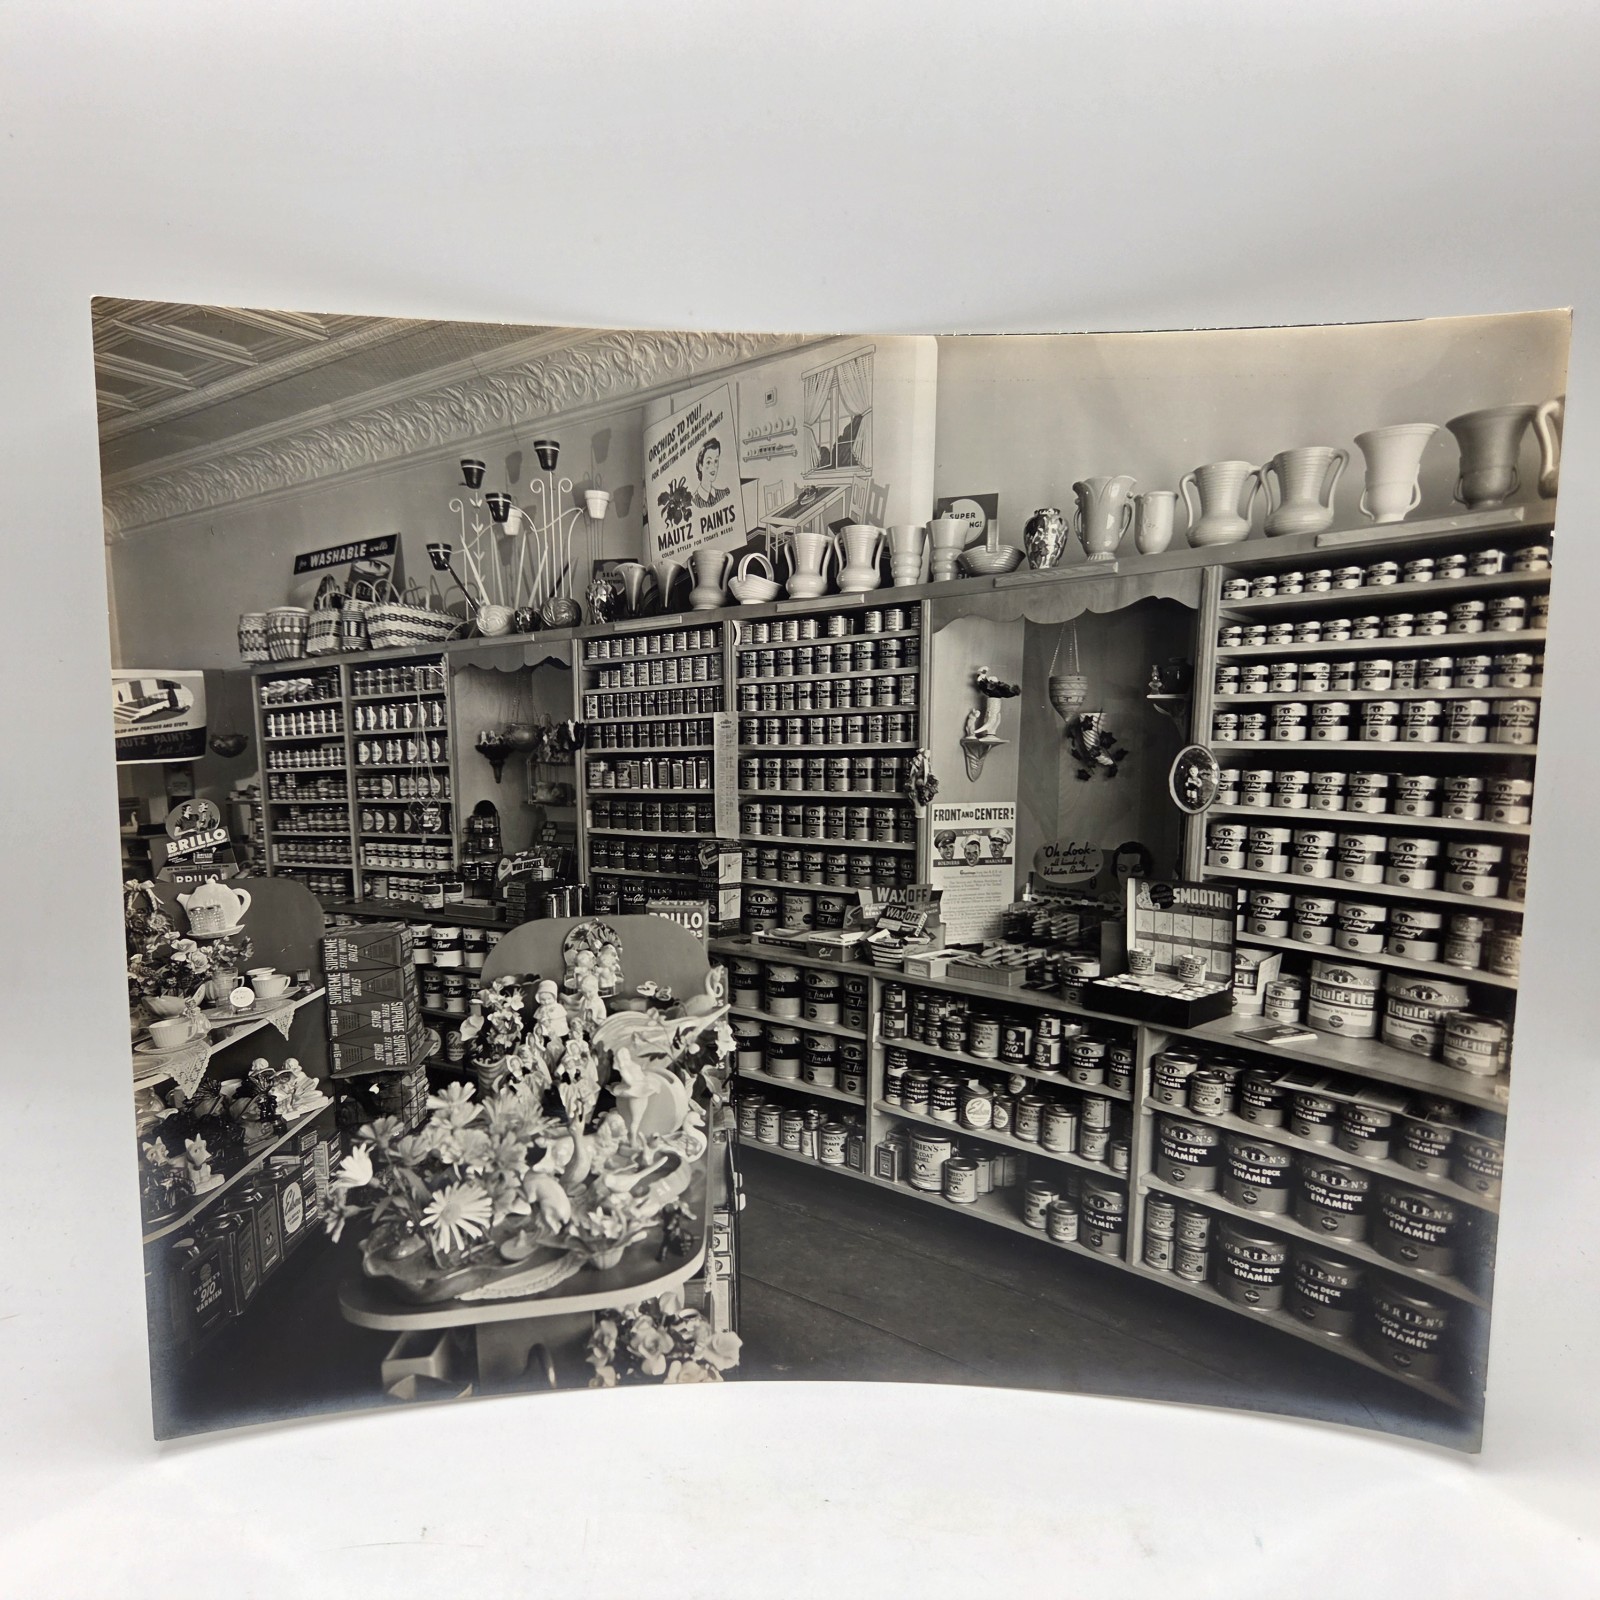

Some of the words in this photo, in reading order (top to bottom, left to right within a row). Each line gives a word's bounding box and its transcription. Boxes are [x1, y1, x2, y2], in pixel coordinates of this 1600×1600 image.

[649, 427, 676, 462] ORCHIDS
[677, 420, 685, 435] TO
[686, 403, 702, 427] YOU!
[668, 442, 678, 456] AND
[691, 410, 713, 435] AMERICA
[651, 470, 659, 482] FOR
[660, 453, 679, 474] INSISTING
[680, 447, 686, 456] ON
[688, 429, 707, 450] COLORFUL
[708, 412, 724, 431] HOMES
[658, 523, 693, 551] MAUTZ
[700, 505, 736, 534] PAINTS
[662, 550, 674, 558] COLOR
[677, 543, 692, 553] STYLED
[694, 539, 702, 548] FOR
[721, 527, 733, 536] NEEDS
[310, 543, 367, 568] WASHABLE
[153, 731, 191, 744] PAINTS
[934, 809, 961, 821] FRONT
[975, 807, 1014, 820] CENTER!
[166, 828, 226, 854] BRILLO
[649, 912, 703, 929] ILLO
[324, 938, 339, 971] SUPREME
[340, 954, 348, 969] STEEL
[328, 973, 342, 1005] SUPREME
[343, 989, 351, 1002] STEEL
[1311, 984, 1374, 1007] Liquid-Lite
[371, 1010, 381, 1028] BALLS
[382, 1003, 390, 1018] STEEL
[391, 1001, 404, 1032] SUPREME
[374, 1043, 384, 1061] BALLS
[384, 1037, 392, 1050] STEEL
[393, 1034, 407, 1065] SUPREME
[1161, 1124, 1213, 1143] 'BRIEN'S
[1164, 1149, 1199, 1163] ENAMEL
[1234, 1169, 1272, 1185] ENAMEL
[1302, 1166, 1368, 1190] O'BRIEN'S
[1304, 1181, 1327, 1195] FLOOR
[1343, 1194, 1363, 1202] DECK
[1311, 1194, 1354, 1211] ENAMEL
[1389, 1221, 1436, 1242] ENAMEL
[1425, 1224, 1447, 1233] DECK
[1225, 1242, 1284, 1262] O'BRIEN'S
[1227, 1257, 1249, 1270] FLOOR
[1234, 1268, 1273, 1282] ENAMEL
[196, 1288, 222, 1313] VARNISH
[200, 1281, 216, 1302] 910
[1320, 1287, 1341, 1297] DECK
[1381, 1326, 1428, 1349] ENAMEL
[1417, 1331, 1438, 1341] DECK
